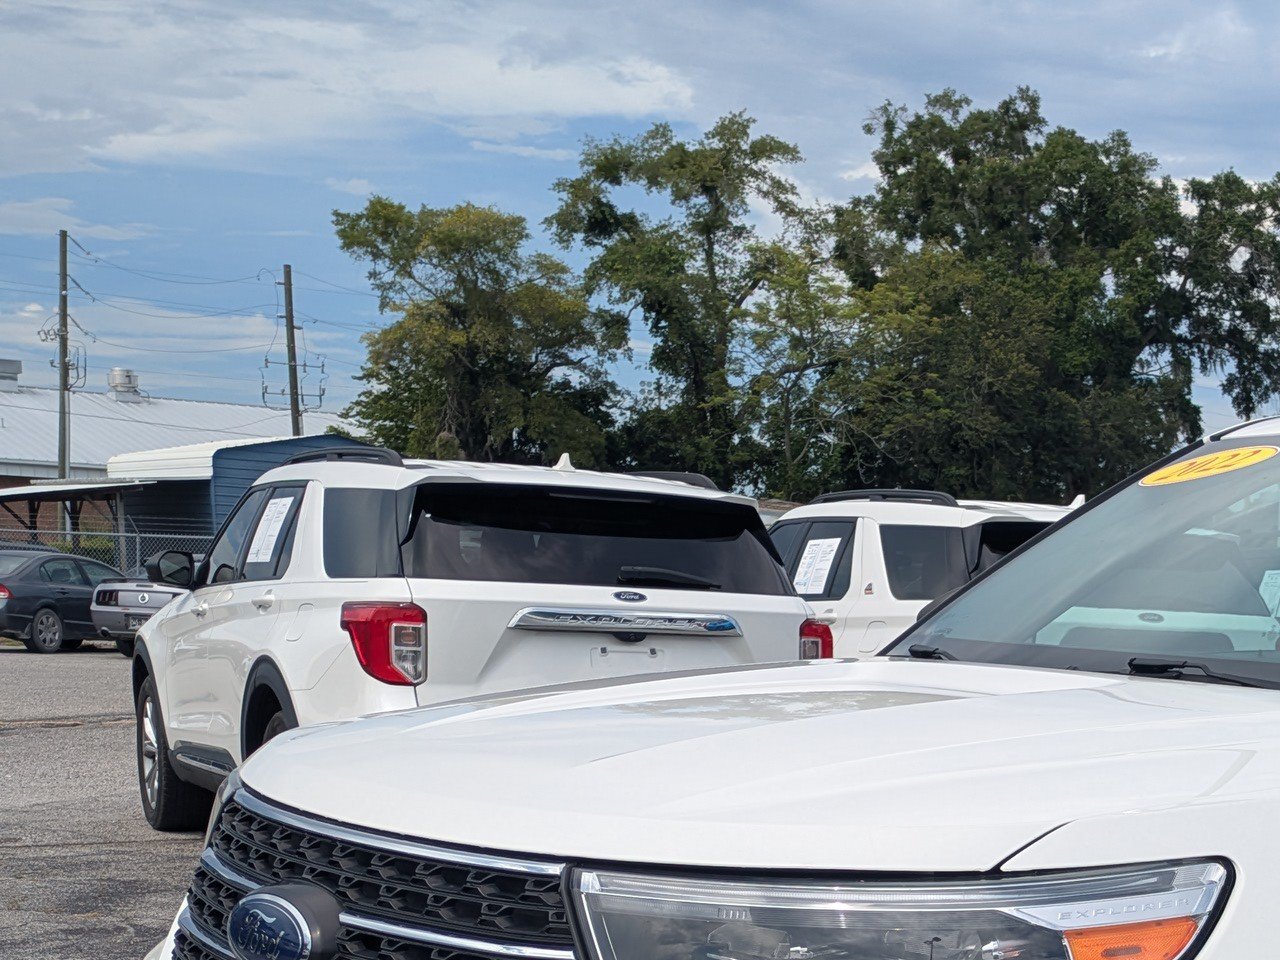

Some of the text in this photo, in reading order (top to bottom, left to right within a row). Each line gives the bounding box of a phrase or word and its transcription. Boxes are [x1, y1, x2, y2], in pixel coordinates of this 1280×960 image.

[619, 592, 641, 601] Ford
[552, 614, 707, 631] EXPLORER
[1058, 899, 1189, 920] EXPLORER
[239, 909, 285, 960] Ford
